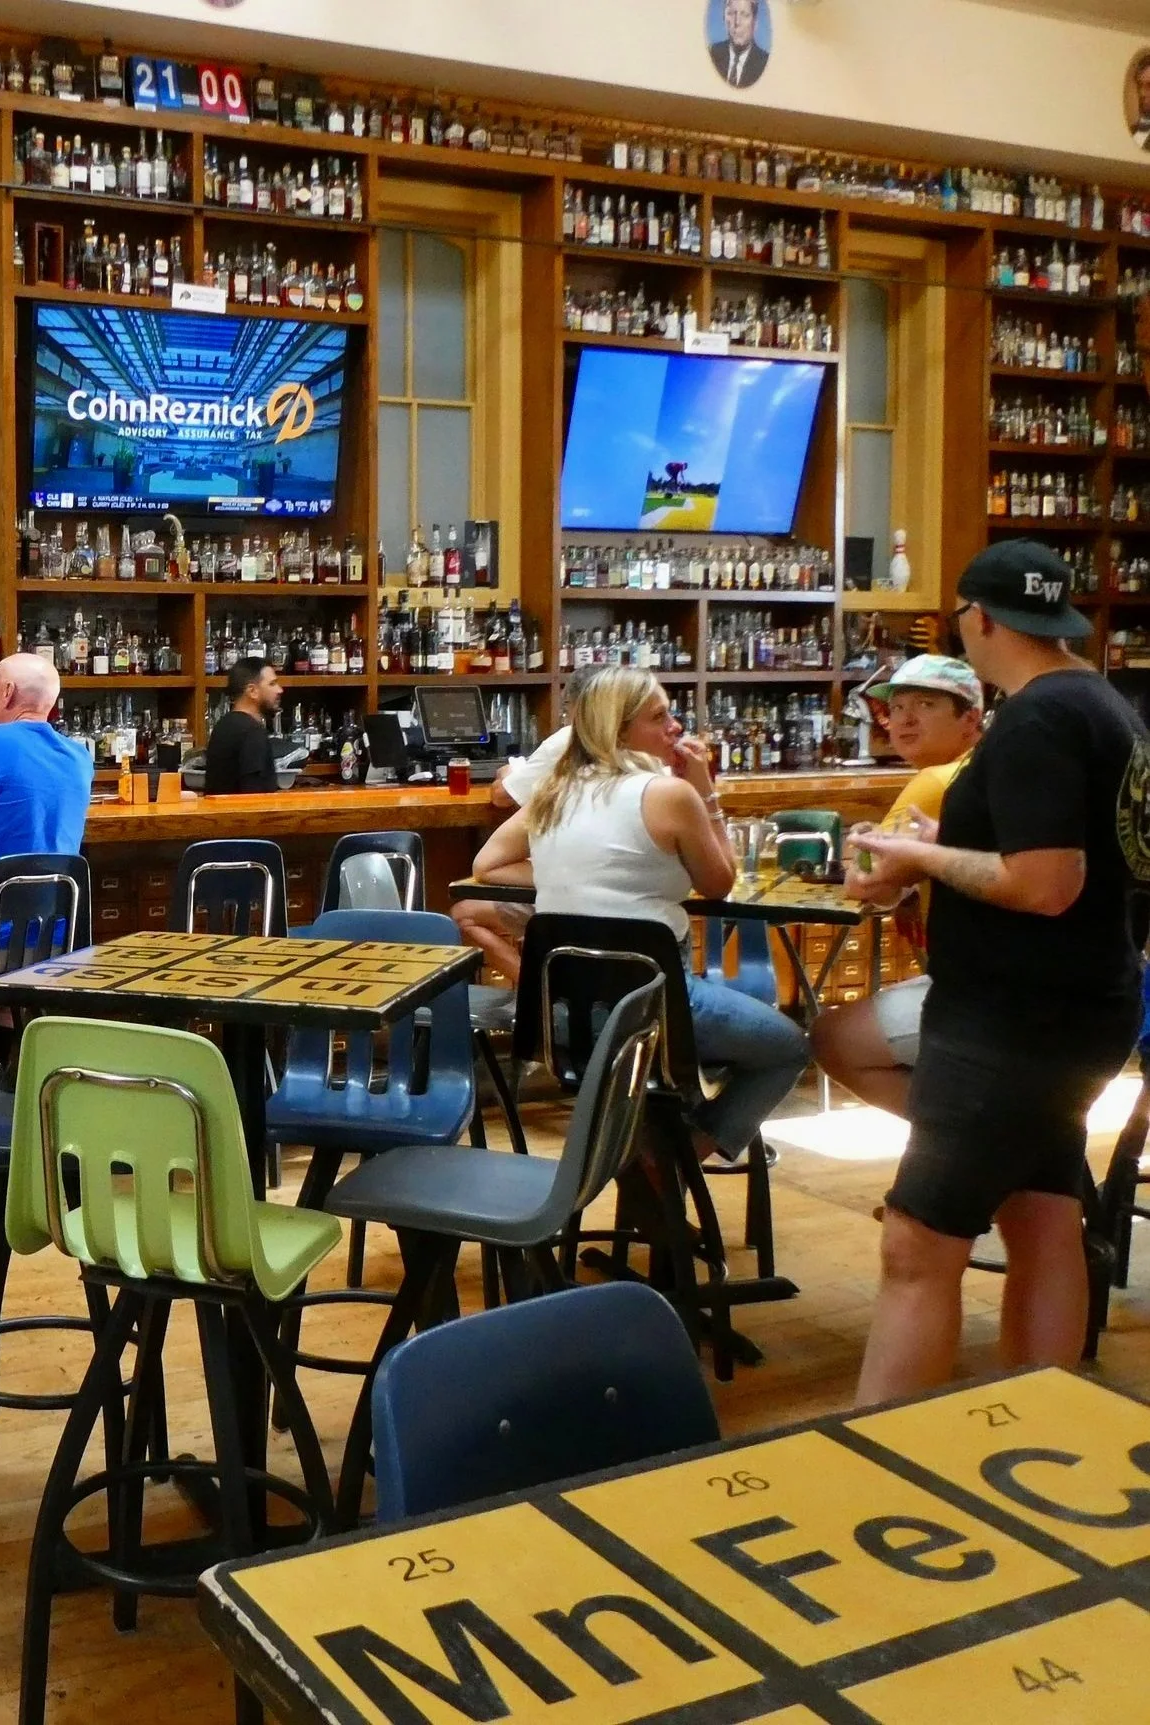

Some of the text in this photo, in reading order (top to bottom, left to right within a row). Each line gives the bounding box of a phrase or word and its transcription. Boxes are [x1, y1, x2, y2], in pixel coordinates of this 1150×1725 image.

[136, 62, 242, 109] 21 00
[67, 389, 264, 428] CohnReznick
[118, 427, 262, 440] ADVISORY ASSURANCE TAX
[33, 965, 126, 981] Sb
[152, 972, 250, 988] Sn
[300, 980, 373, 996] In
[967, 1402, 1021, 1428] 27
[706, 1470, 771, 1498] 26
[388, 1550, 456, 1584] 25
[692, 1515, 998, 1626] Fe
[315, 1592, 717, 1725] Mn
[1012, 1656, 1084, 1694] 44
